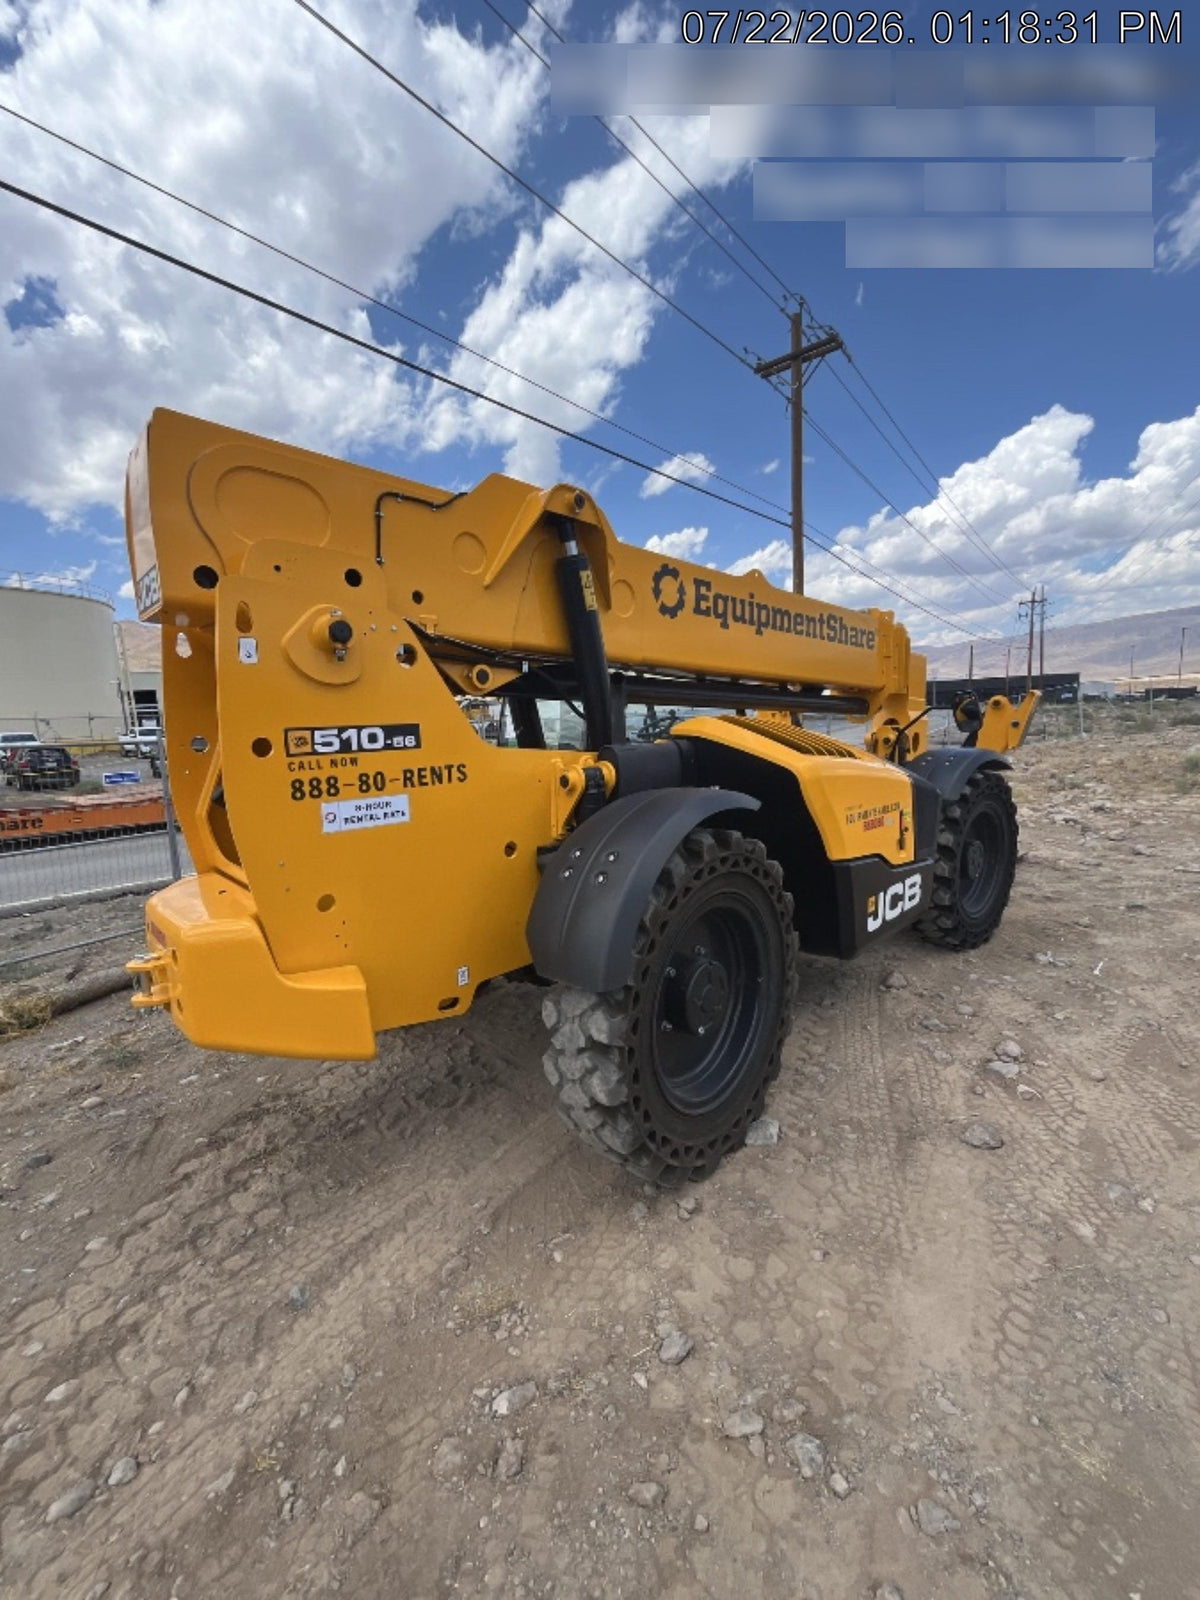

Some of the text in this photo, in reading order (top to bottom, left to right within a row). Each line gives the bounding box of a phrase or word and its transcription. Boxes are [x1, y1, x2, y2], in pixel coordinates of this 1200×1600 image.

[693, 577, 876, 651] EquipmentShare
[287, 756, 359, 772] CALL NOW
[290, 763, 468, 801] 888-80-RENTS
[867, 873, 922, 932] JCB
